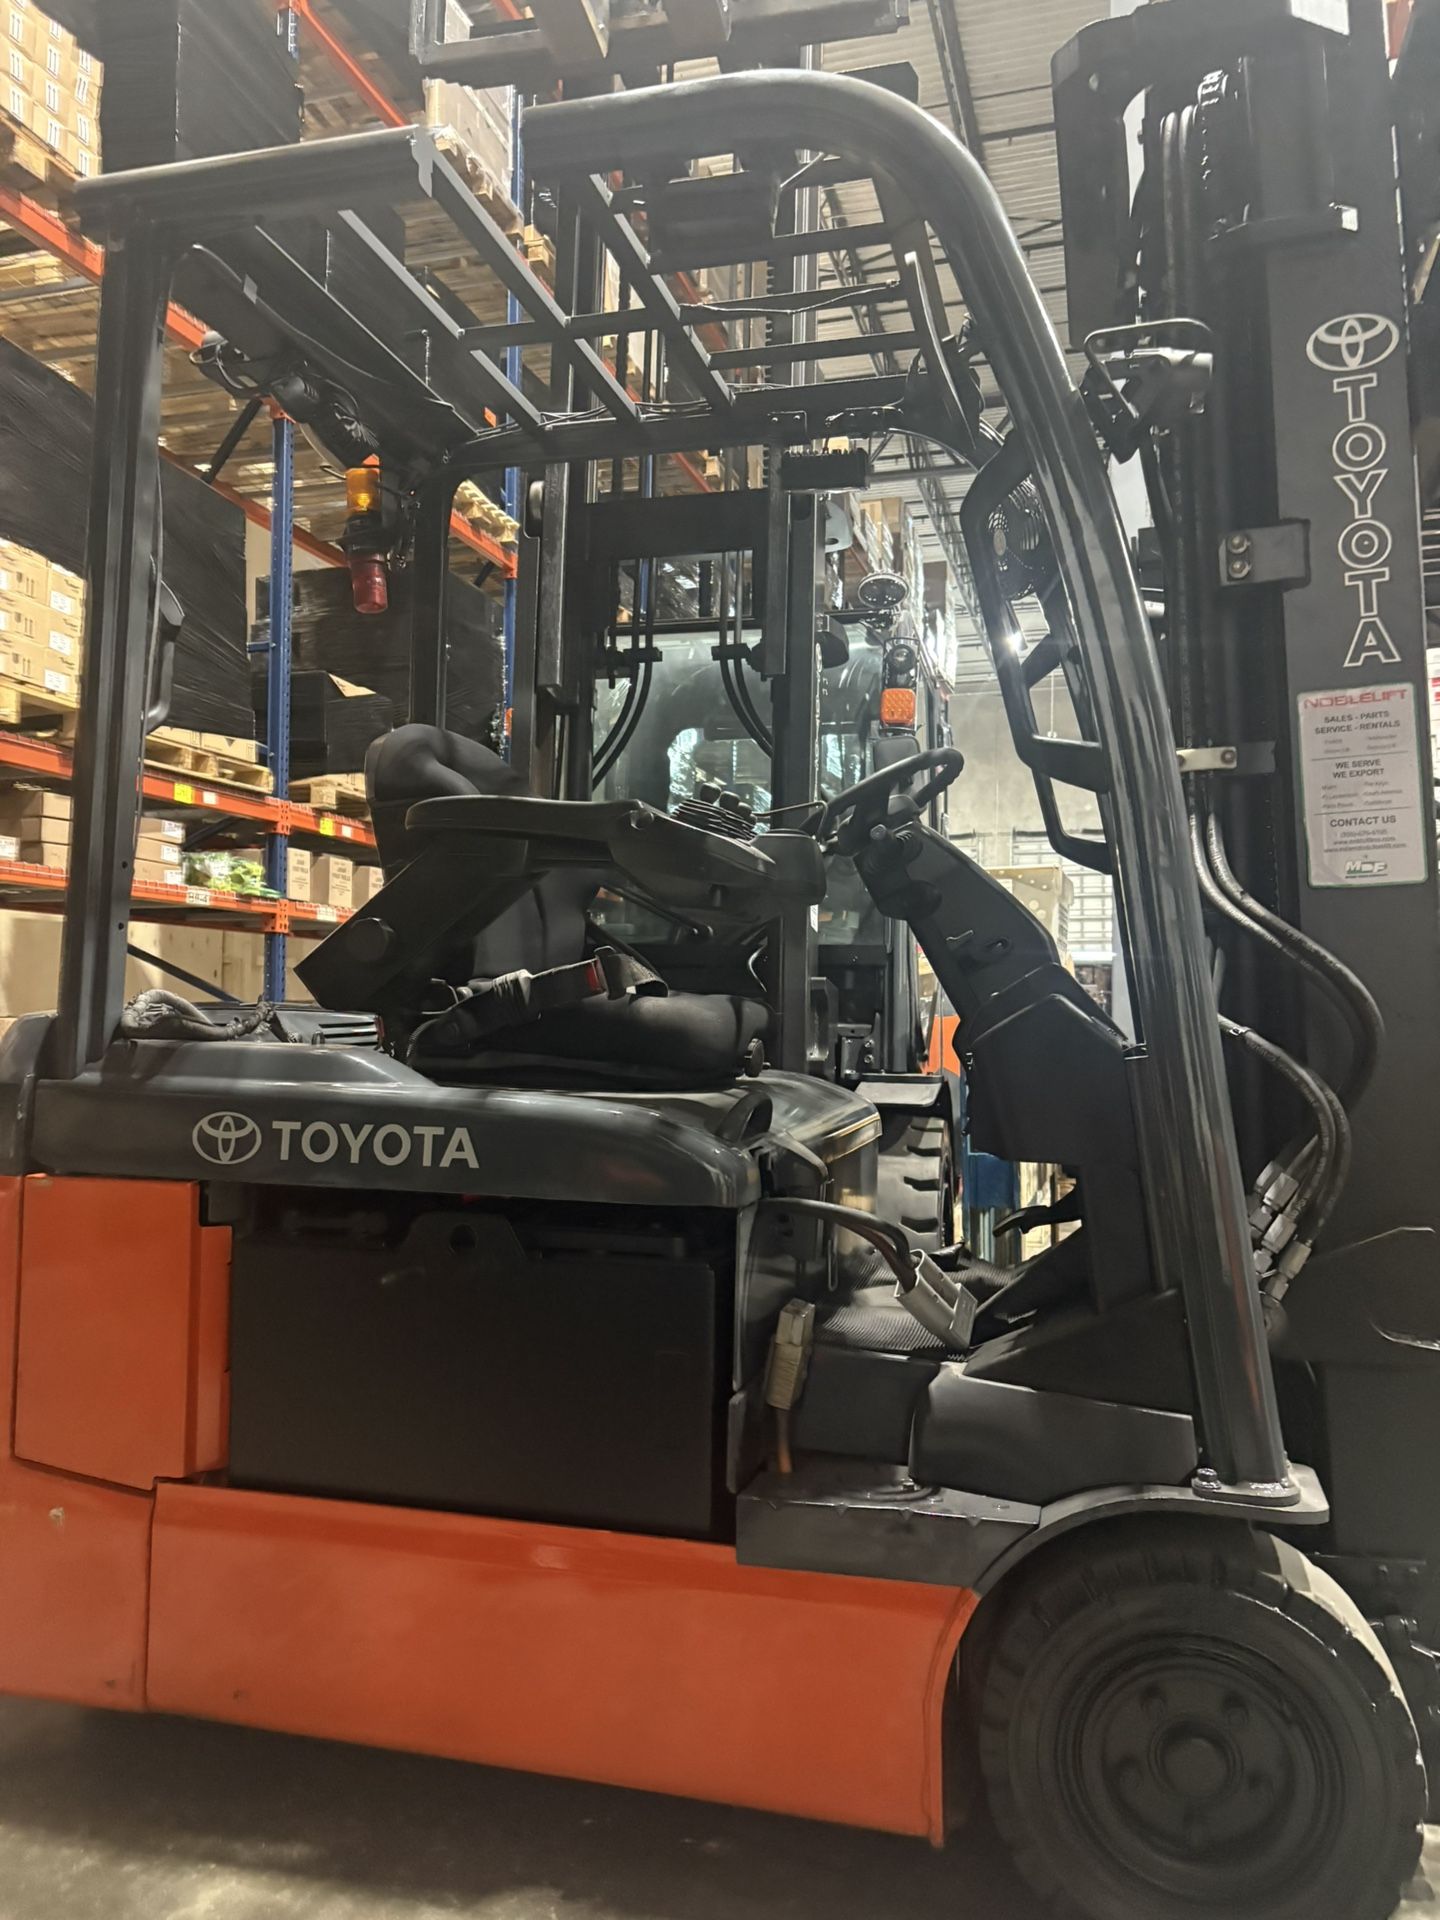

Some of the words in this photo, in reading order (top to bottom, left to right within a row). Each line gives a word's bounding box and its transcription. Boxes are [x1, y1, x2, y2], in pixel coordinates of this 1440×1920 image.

[1332, 372, 1401, 667] TOYOTA
[1304, 689, 1406, 709] NOBLELIFT
[1324, 714, 1353, 723] SALES
[1360, 710, 1390, 720] PARTS
[1315, 725, 1352, 734] SERVICE
[1359, 720, 1401, 731] RENTALS
[1335, 761, 1350, 769] WE
[1352, 758, 1382, 768] SERVE
[1332, 771, 1348, 779] WE
[1349, 768, 1385, 778] EXPORT
[1329, 816, 1379, 828] CONTACT
[1382, 815, 1397, 824] US
[272, 1120, 480, 1169] TOYOTA
